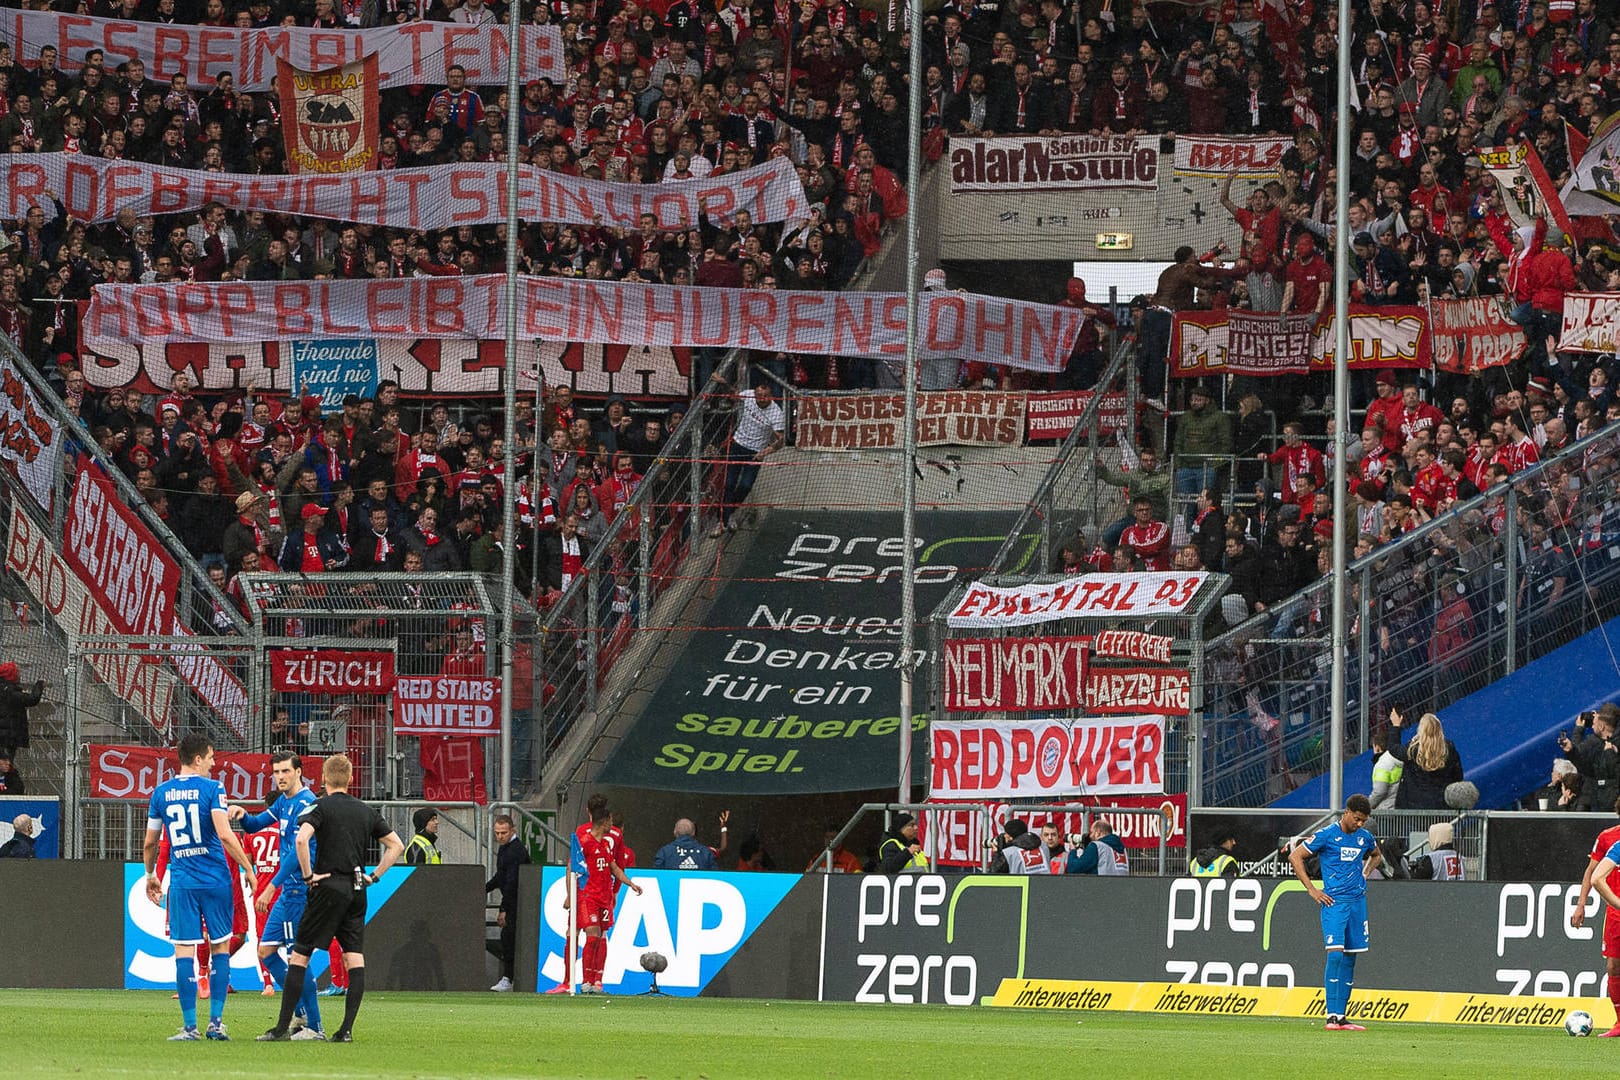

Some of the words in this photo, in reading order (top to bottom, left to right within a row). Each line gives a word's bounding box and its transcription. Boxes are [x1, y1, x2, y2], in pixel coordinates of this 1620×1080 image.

[153, 26, 290, 86] BEIM
[290, 147, 373, 173] MÜNCHEN
[1189, 142, 1283, 170] REBELS
[7, 163, 48, 217] R
[65, 162, 191, 222] DFB
[451, 171, 594, 221] SEIN
[93, 284, 257, 337] HOPP
[275, 278, 508, 335] BLEIBT
[526, 278, 624, 341] EIN
[296, 341, 374, 361] Freunde
[1230, 332, 1310, 357] JUNGS!
[1471, 331, 1525, 366] PRIDE
[300, 364, 341, 384] sind
[344, 364, 373, 383] nie
[1029, 398, 1075, 413] FREIHEIT
[799, 422, 895, 448] IMMER
[957, 415, 1018, 444] UNS
[787, 533, 925, 557] pre
[7, 507, 67, 615] BAD
[775, 559, 957, 584] zero
[1148, 576, 1200, 606] 93
[724, 639, 927, 673] Denken
[1096, 630, 1139, 656] LETZTE
[1137, 635, 1174, 662] REIHE
[285, 655, 382, 687] ZÜRICH
[944, 640, 1089, 706] NEUMARKT
[397, 679, 433, 700] RED
[437, 679, 493, 701] STARS
[702, 674, 783, 703] für
[793, 680, 873, 705] ein
[1085, 674, 1190, 708] HARZBURG
[401, 703, 494, 727] UNITED
[676, 712, 929, 740] sauberes
[655, 743, 804, 774] Spiel.
[932, 728, 1004, 790] RED
[1010, 723, 1162, 790] POWER
[165, 789, 199, 802] HÜBNER
[427, 783, 486, 801] DAVIES
[166, 803, 202, 847] 21
[253, 836, 280, 866] 24
[1341, 850, 1357, 859] SAP
[1237, 861, 1297, 876] ISTORISCHE
[858, 874, 946, 944] pre
[1166, 878, 1262, 949] pre
[1497, 883, 1601, 957] pre
[283, 921, 293, 940] 11
[855, 954, 977, 1006] zero
[1496, 968, 1608, 998] zer
[1013, 981, 1112, 1010] interwetten
[1154, 985, 1258, 1014] interwetten
[1456, 995, 1566, 1026] interwetten
